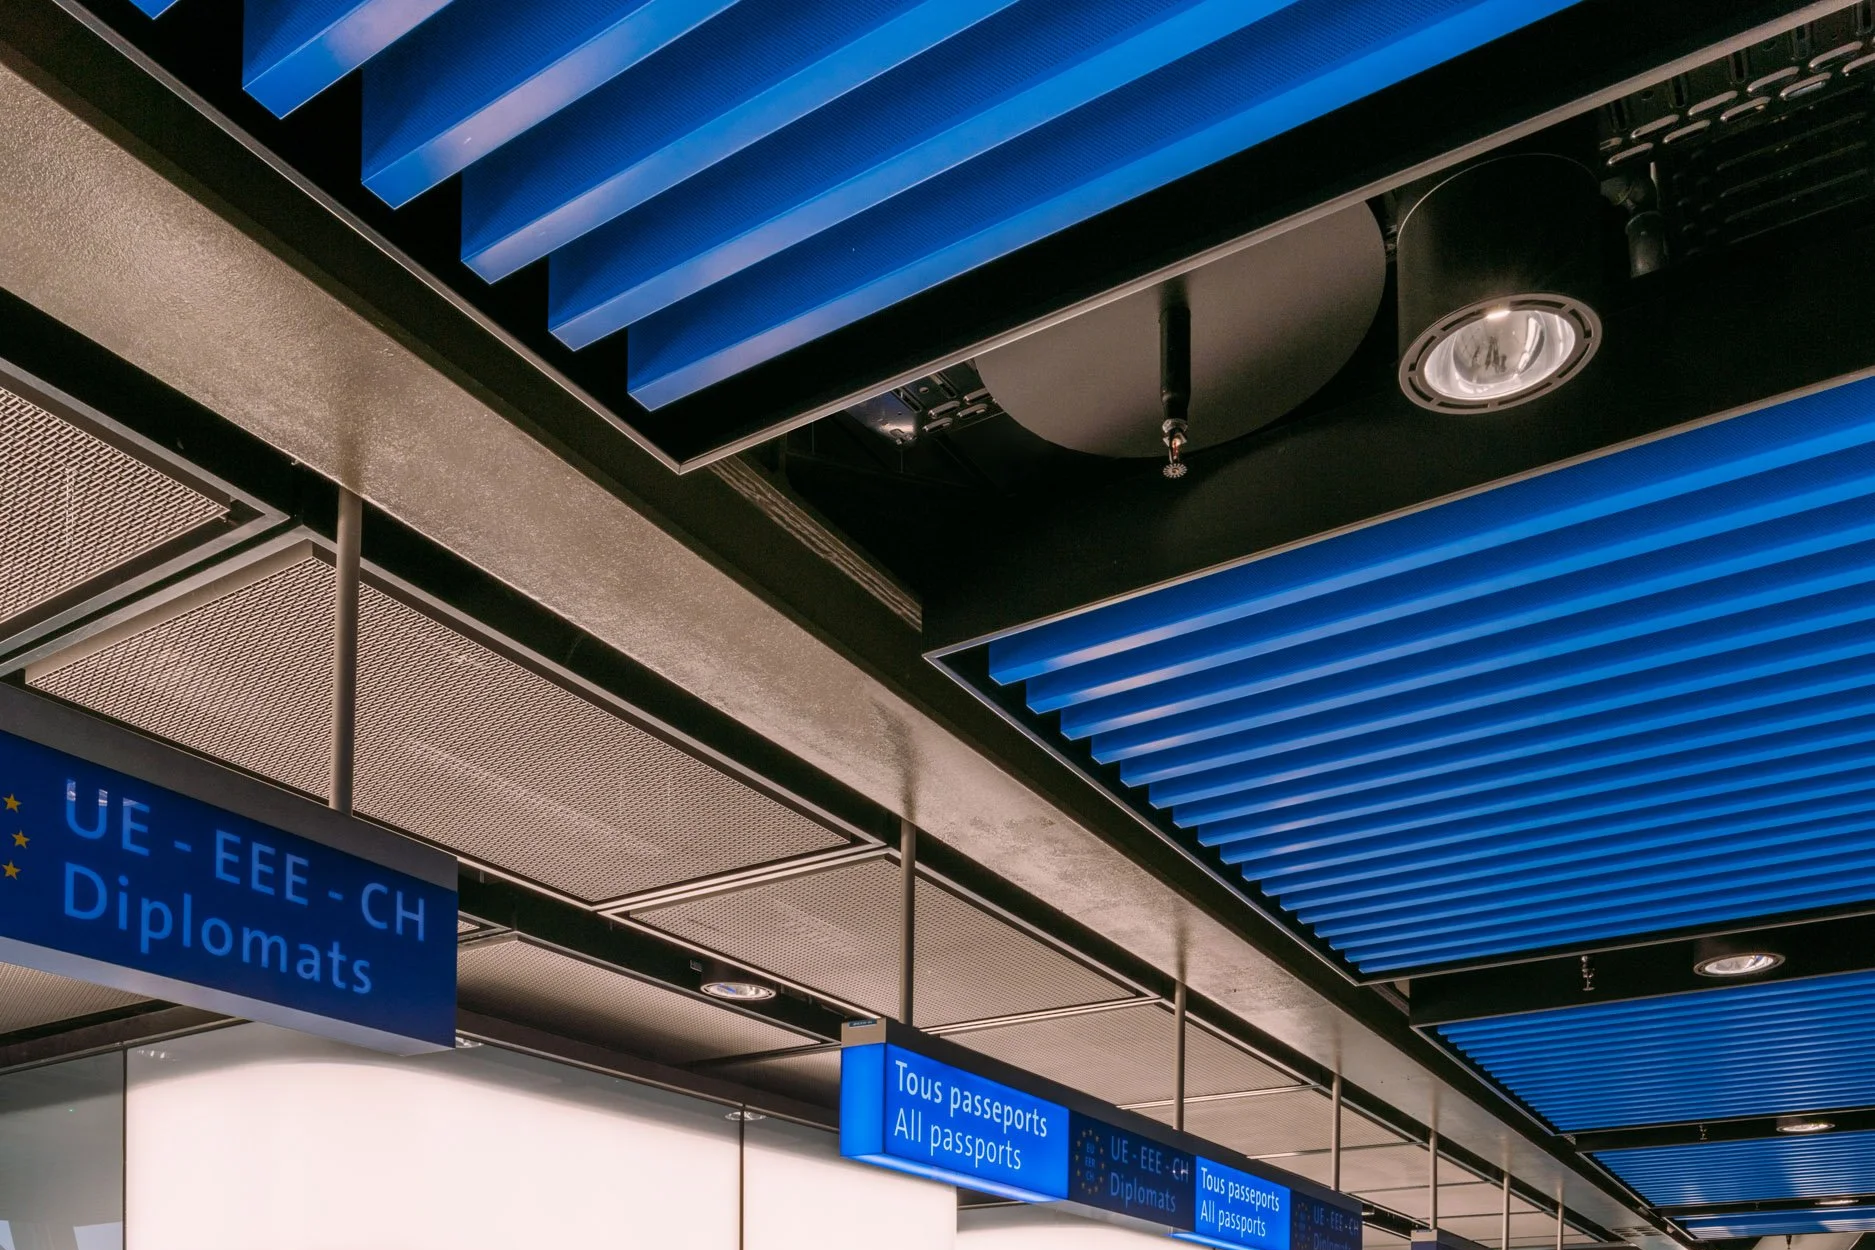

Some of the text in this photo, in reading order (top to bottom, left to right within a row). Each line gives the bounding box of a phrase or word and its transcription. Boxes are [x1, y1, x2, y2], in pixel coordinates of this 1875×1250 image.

[66, 778, 151, 856] UE
[215, 829, 310, 906] EEE
[361, 882, 425, 942] CH
[64, 861, 373, 995] Diplomats
[895, 1059, 1048, 1138] Tous passeports
[894, 1107, 1022, 1170] All passports
[1111, 1135, 1129, 1165] UE
[1140, 1145, 1162, 1175] EEE
[1172, 1158, 1189, 1183] CH
[1110, 1171, 1177, 1213] Diplomats
[1200, 1166, 1280, 1213] Tous passeports
[1200, 1199, 1215, 1224] All
[1218, 1209, 1266, 1239] passports
[1313, 1204, 1325, 1226] UE
[1330, 1210, 1344, 1232] EEE
